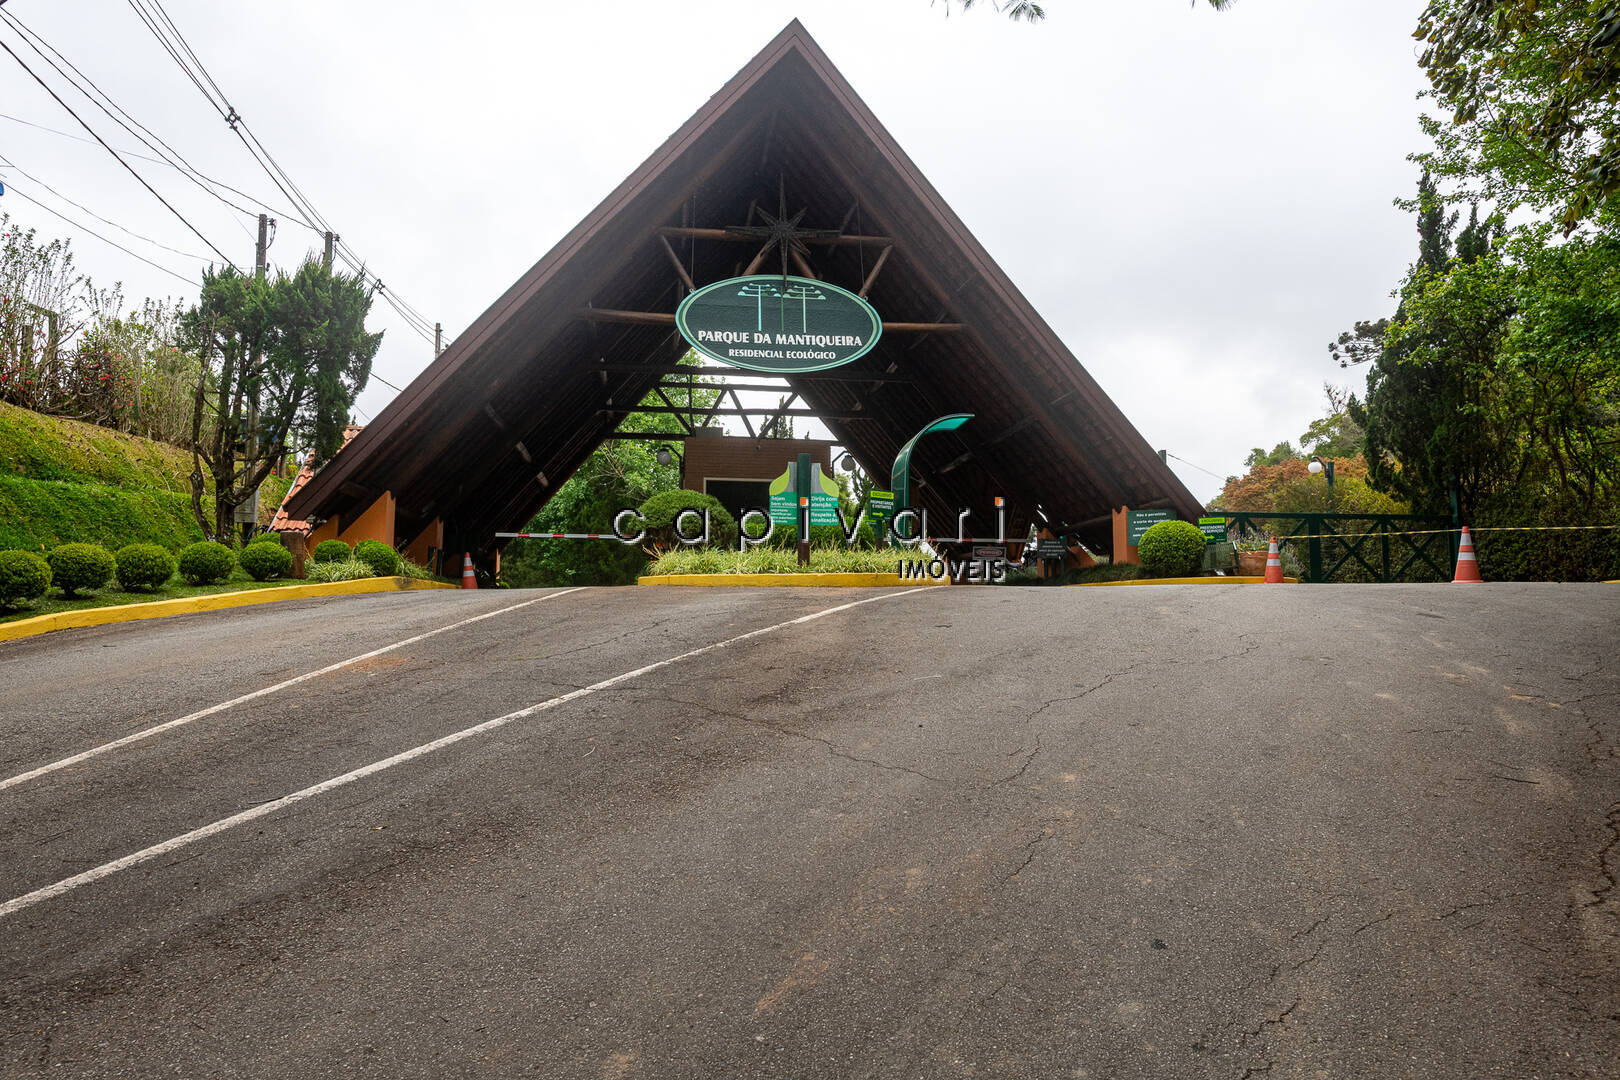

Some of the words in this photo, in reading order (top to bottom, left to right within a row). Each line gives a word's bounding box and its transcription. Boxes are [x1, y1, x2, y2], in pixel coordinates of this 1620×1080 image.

[697, 330, 749, 344] PARQUE
[753, 332, 772, 344] DA
[775, 333, 862, 348] MANTIQUEIRA
[728, 348, 784, 359] RESIDENCIAL
[786, 349, 836, 360] ECOLÓGICO
